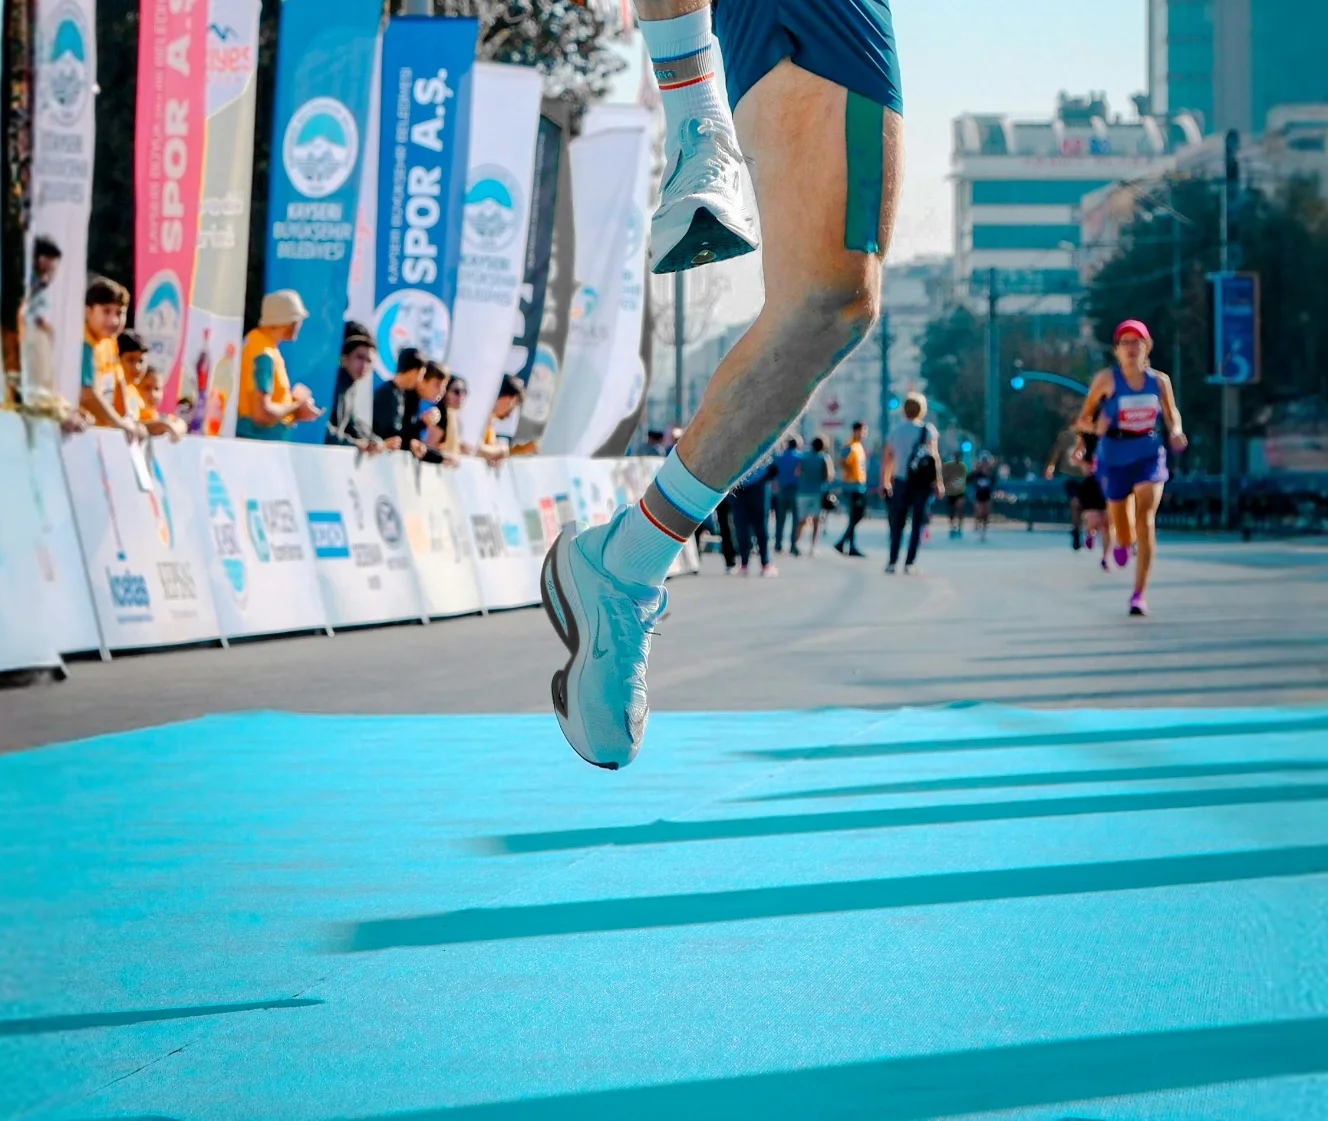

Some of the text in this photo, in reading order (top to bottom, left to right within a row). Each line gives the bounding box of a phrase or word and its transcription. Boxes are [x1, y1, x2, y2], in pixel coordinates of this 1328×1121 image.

[161, 97, 190, 254] SPOR
[402, 67, 454, 284] SPOR A.Ş.
